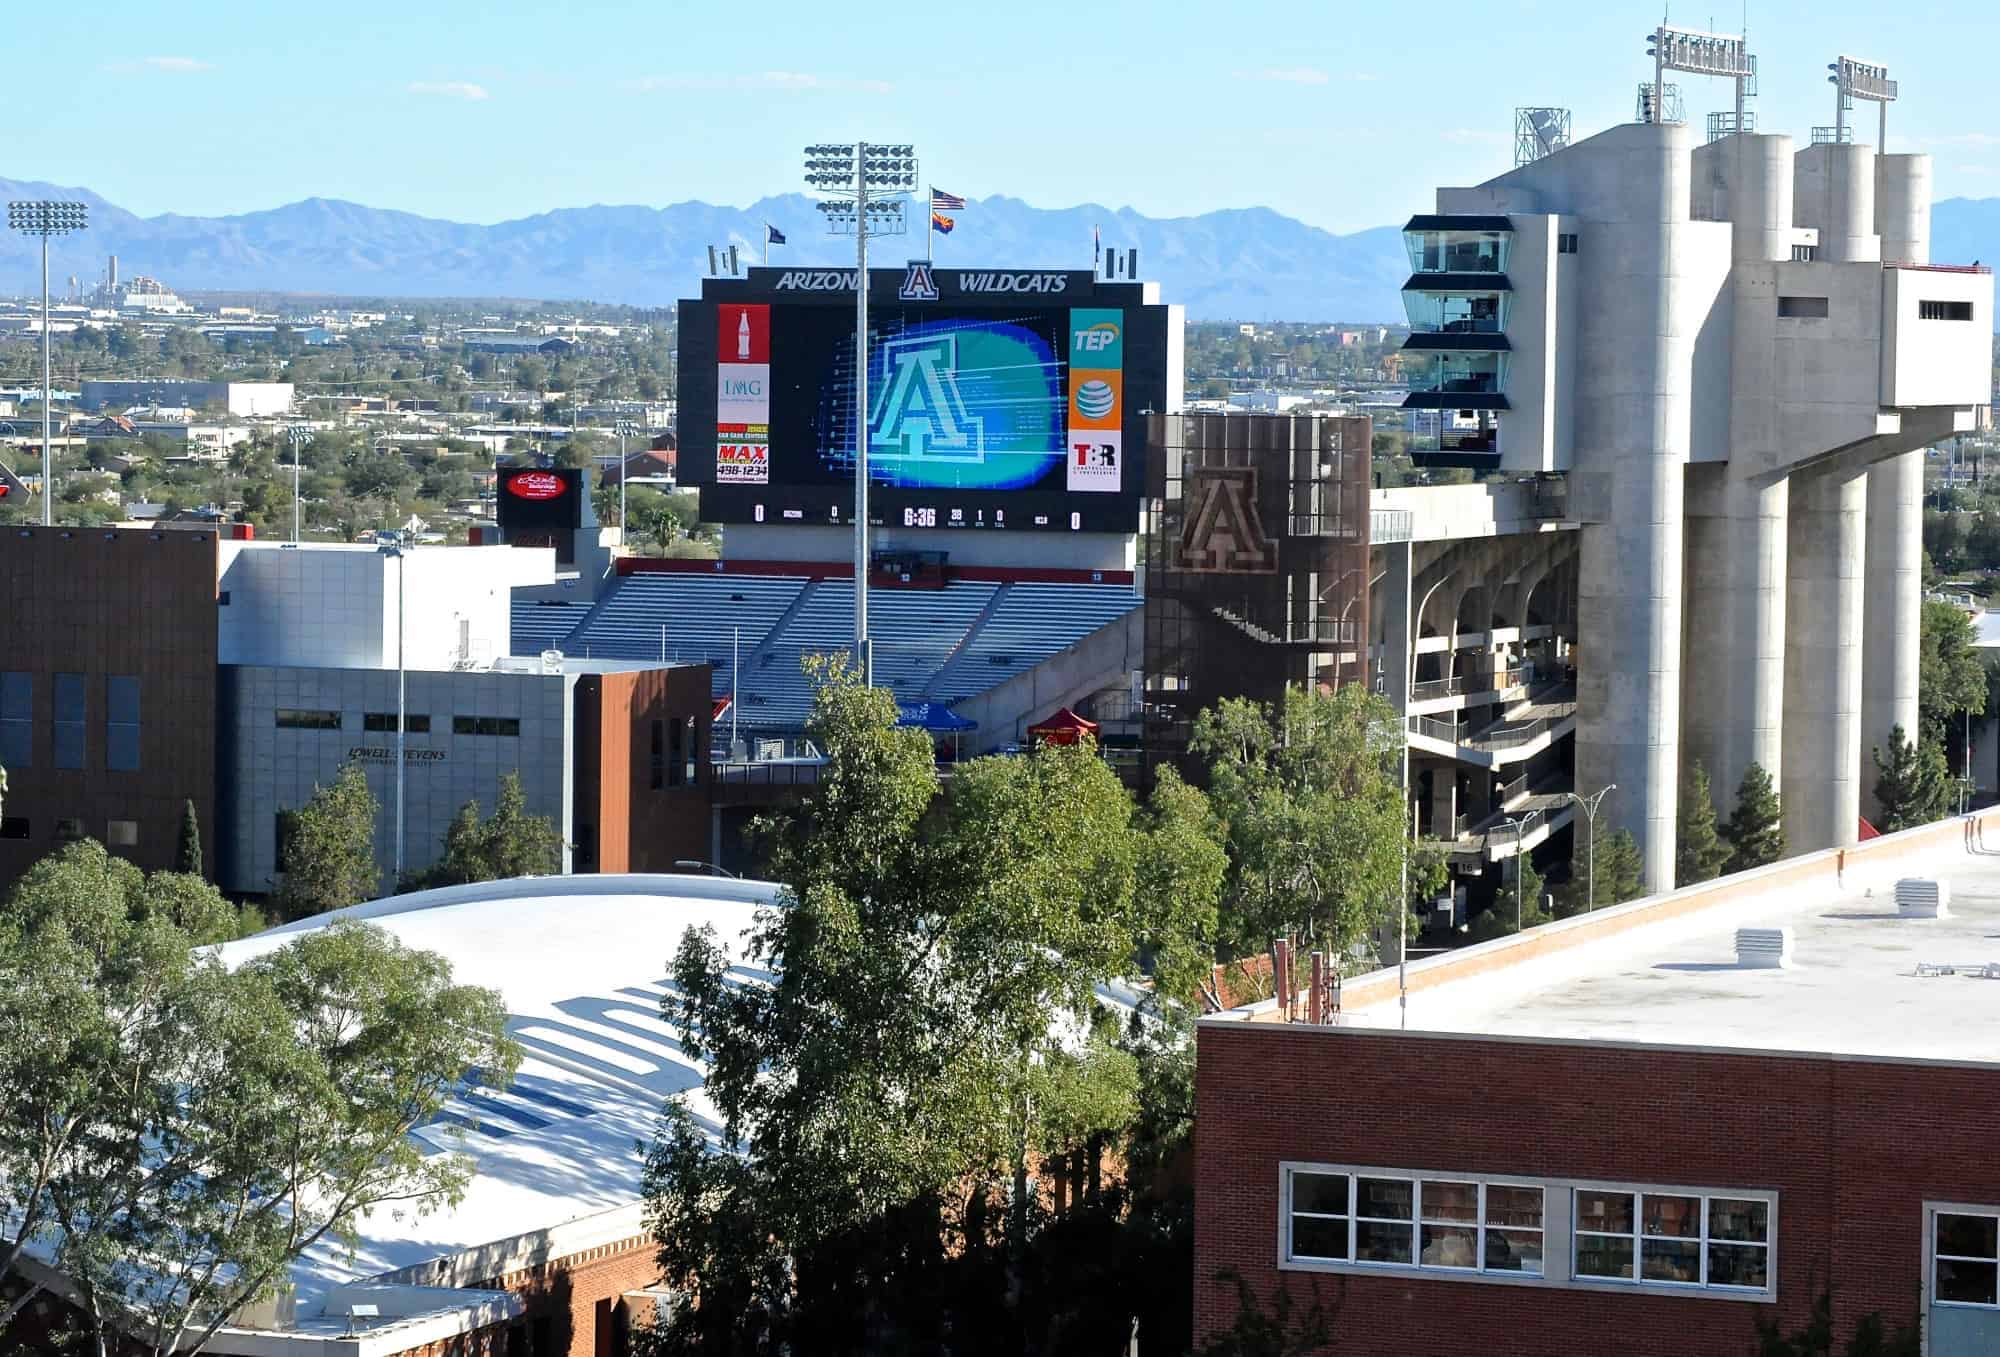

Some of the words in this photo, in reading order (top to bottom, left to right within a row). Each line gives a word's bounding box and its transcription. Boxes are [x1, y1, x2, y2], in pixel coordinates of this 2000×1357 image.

[959, 273, 1068, 293] WILDCATS
[1074, 331, 1114, 352] TEP
[725, 380, 761, 396] IMG
[867, 333, 985, 464] A
[719, 446, 767, 459] MAX
[718, 465, 767, 476] 498-1234
[755, 504, 764, 522] 0
[904, 507, 936, 527] 6:36
[1071, 511, 1081, 530] 0
[1170, 467, 1280, 575] A
